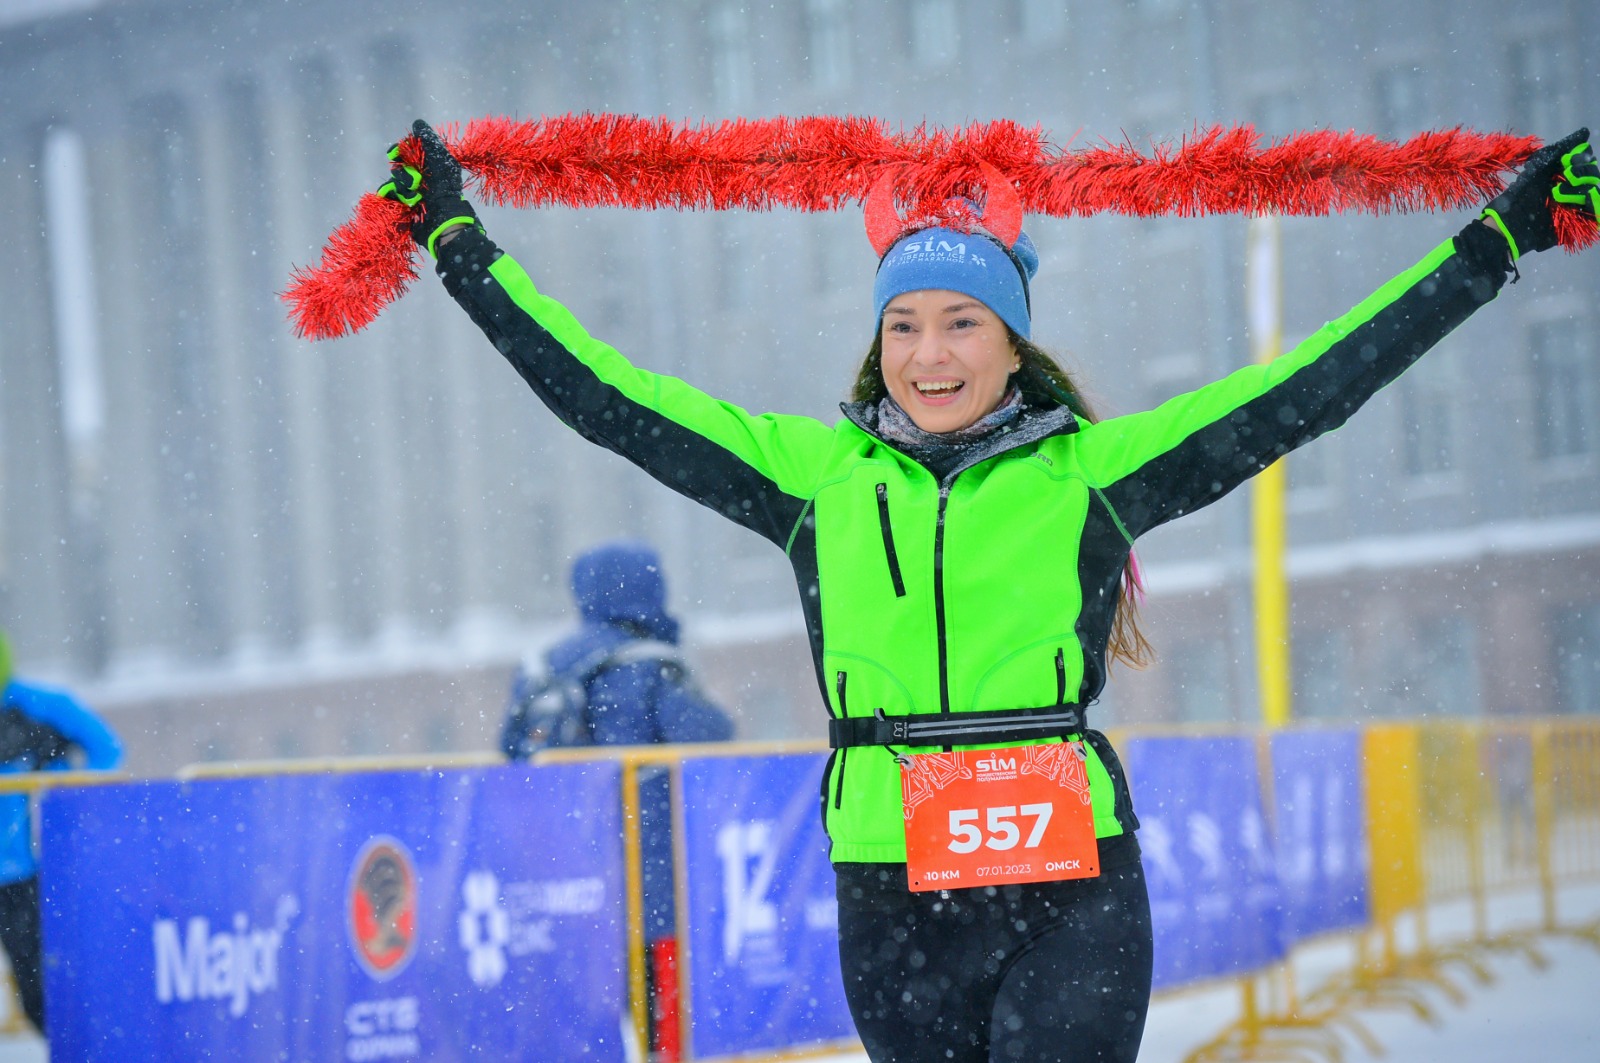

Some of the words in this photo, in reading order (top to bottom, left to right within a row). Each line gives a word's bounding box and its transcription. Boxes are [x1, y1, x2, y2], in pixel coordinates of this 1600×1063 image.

[900, 252, 944, 261] SIBERIAN
[948, 252, 966, 260] ICE
[947, 802, 1053, 854] 557
[976, 863, 1032, 877] 07.01.2023
[1045, 860, 1081, 872] ОМСК
[926, 870, 939, 881] 10
[152, 912, 282, 1019] Major
